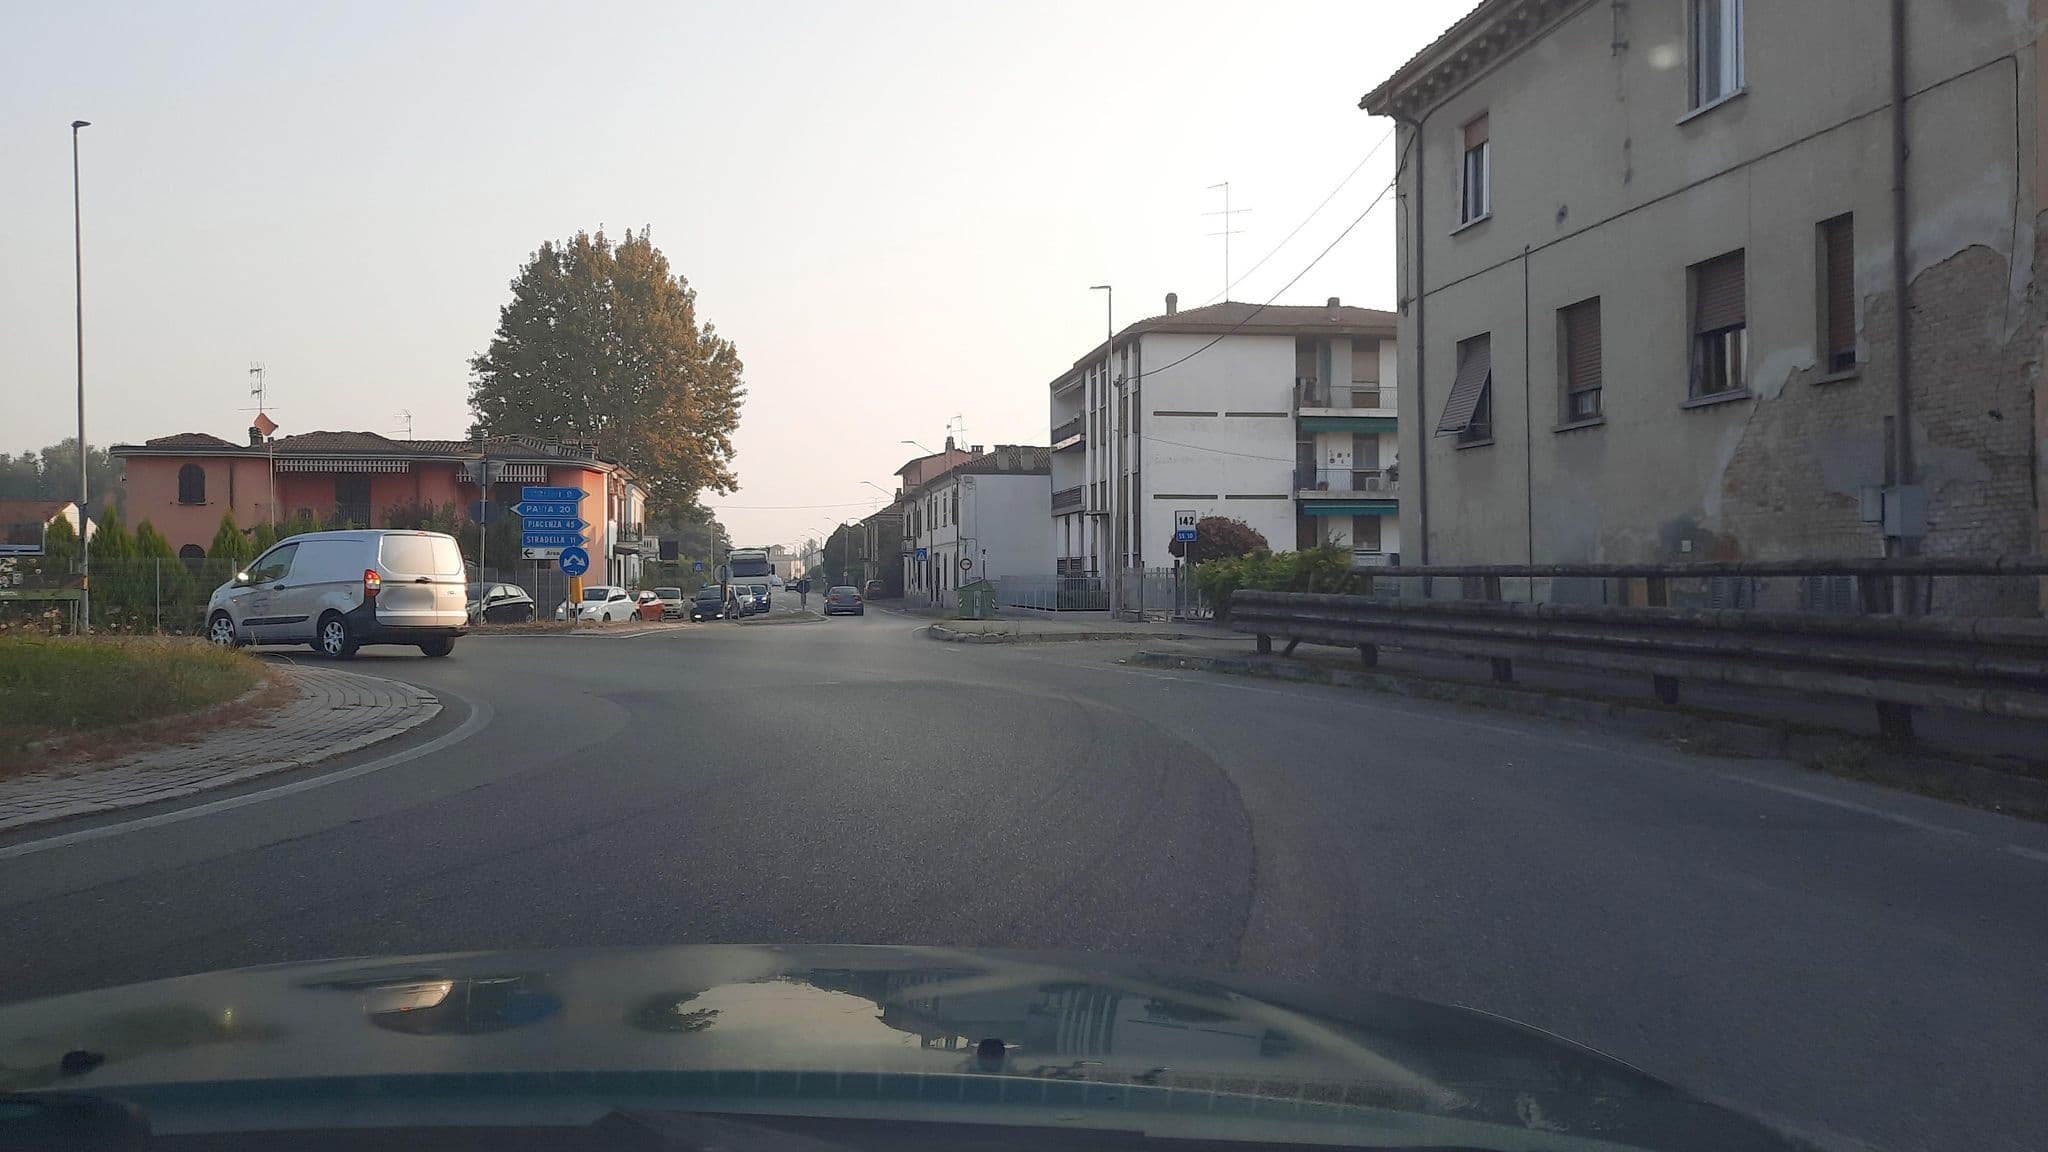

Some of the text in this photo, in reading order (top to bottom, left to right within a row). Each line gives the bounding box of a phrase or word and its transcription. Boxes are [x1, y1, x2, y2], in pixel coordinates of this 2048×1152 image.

[559, 505, 571, 513] 20
[527, 520, 575, 529] PIACENZA 45
[1178, 516, 1194, 526] 142
[526, 536, 565, 544] STRADELLA
